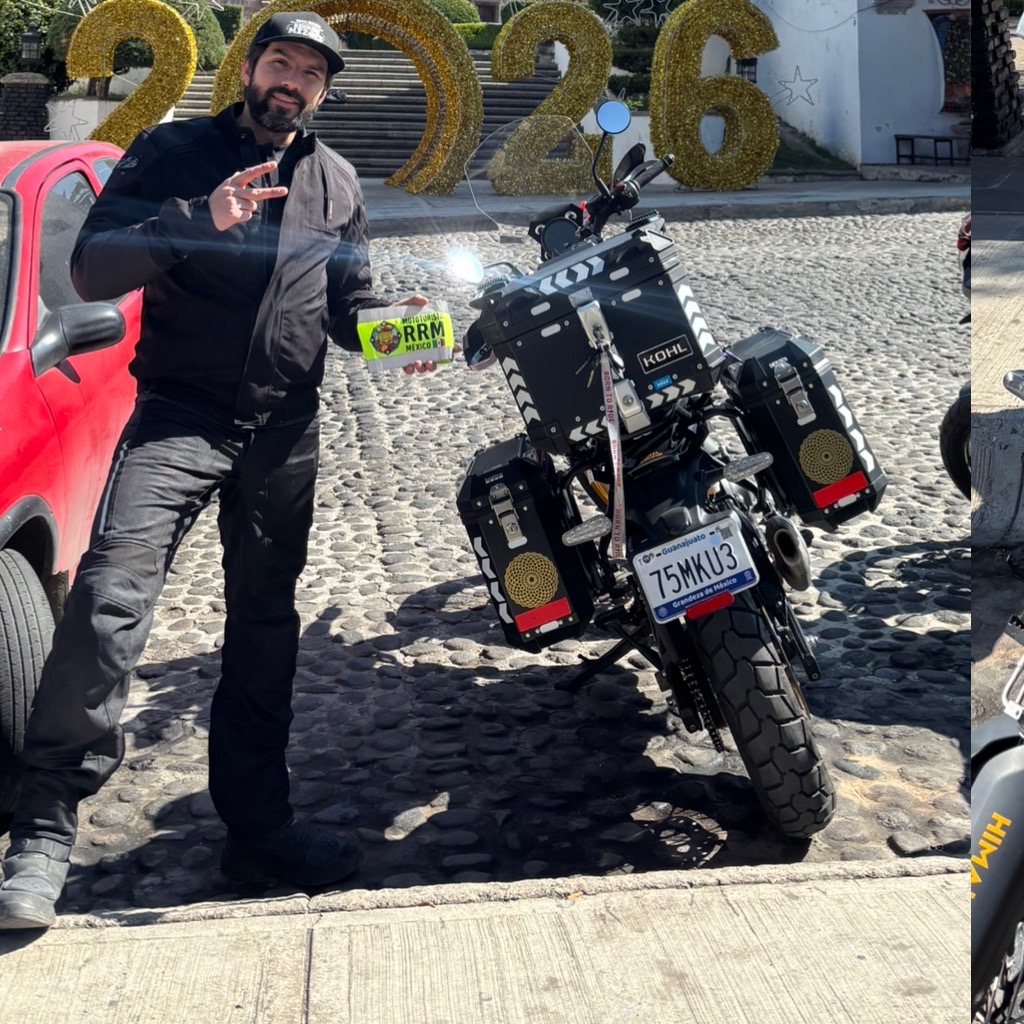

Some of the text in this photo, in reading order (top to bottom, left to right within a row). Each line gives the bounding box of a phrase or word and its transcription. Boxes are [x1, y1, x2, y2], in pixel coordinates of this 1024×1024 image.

[403, 321, 445, 343] RRM
[406, 341, 432, 352] MEXICO
[643, 343, 688, 367] KOHL
[661, 533, 706, 556] Guanajuato
[649, 542, 738, 599] 75MKU3
[672, 577, 738, 608] Grandeza de México
